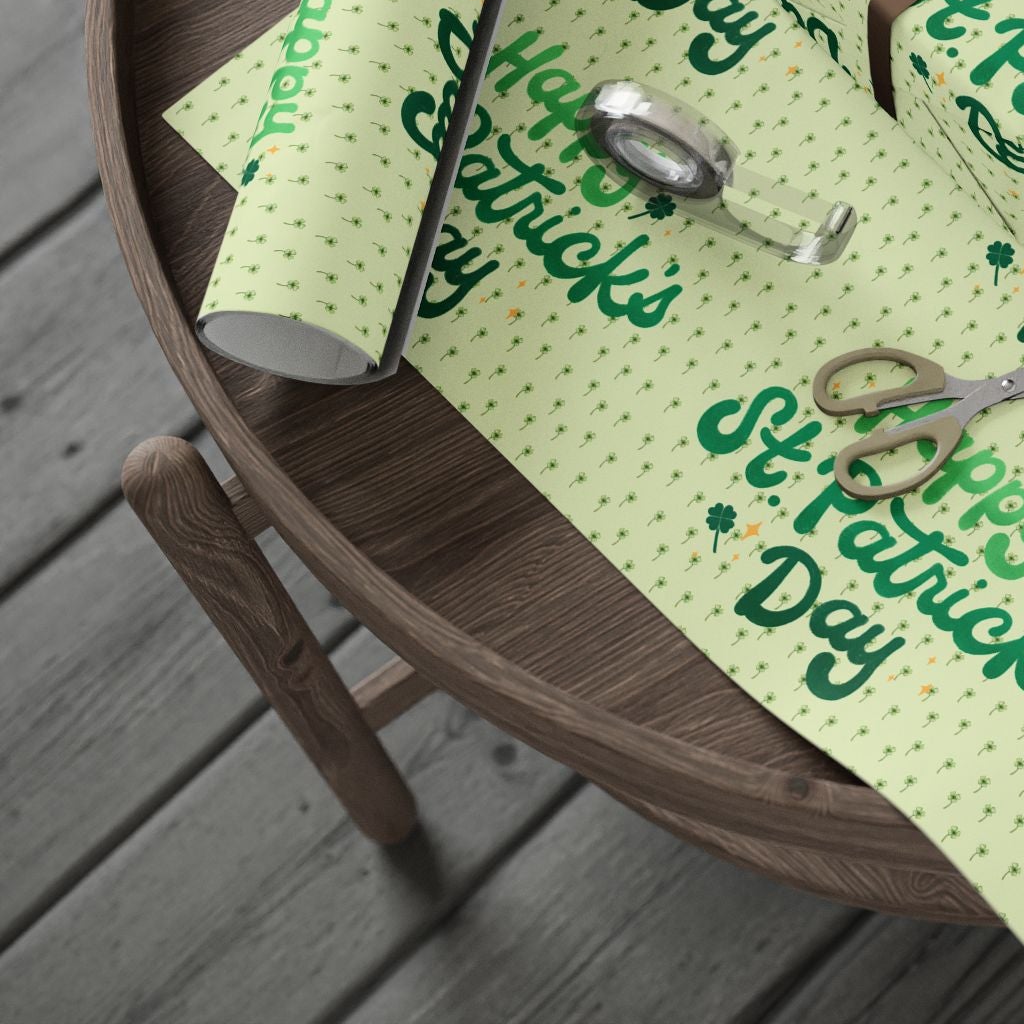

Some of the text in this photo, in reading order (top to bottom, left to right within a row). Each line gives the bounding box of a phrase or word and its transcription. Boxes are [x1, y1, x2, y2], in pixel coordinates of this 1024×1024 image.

[418, 223, 500, 319] ay
[697, 386, 822, 507] St.
[734, 545, 906, 701] Day
